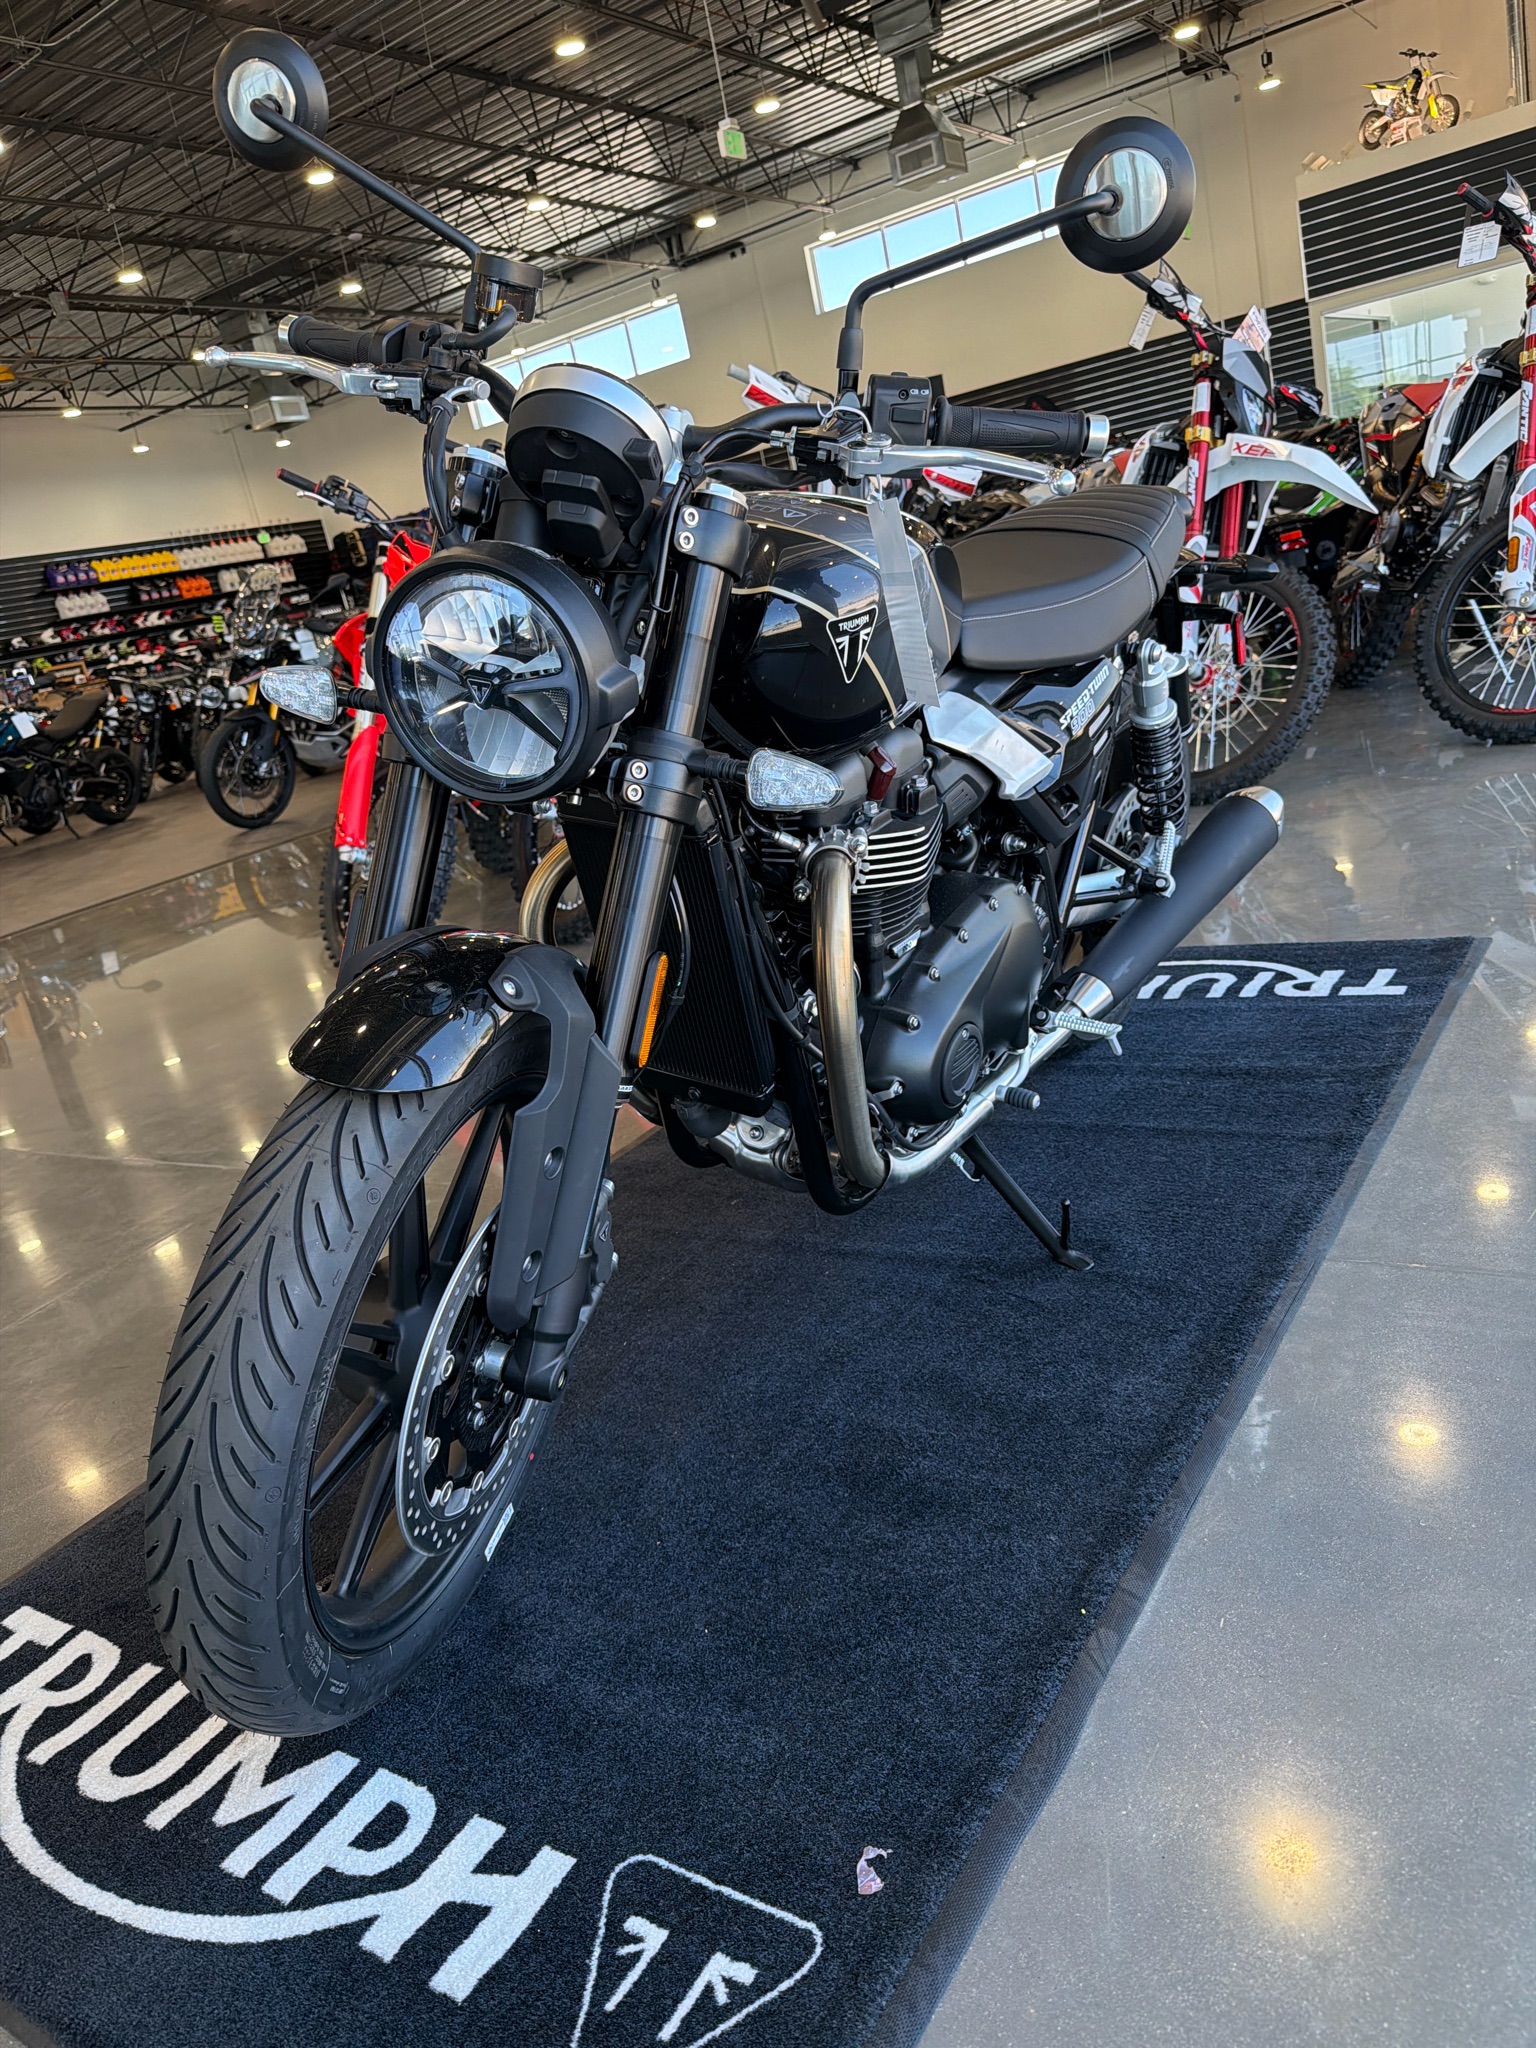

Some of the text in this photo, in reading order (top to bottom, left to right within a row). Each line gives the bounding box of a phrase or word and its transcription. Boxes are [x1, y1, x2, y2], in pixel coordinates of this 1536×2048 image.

[1520, 380, 1533, 442] FANTIC
[1187, 457, 1200, 507] FANT
[838, 613, 870, 631] TRIUMPH
[1059, 664, 1110, 730] SPEED TWIN
[1070, 698, 1096, 735] 900
[1136, 967, 1408, 1000] TRIU
[0, 1605, 578, 2005] TRIUMPH
